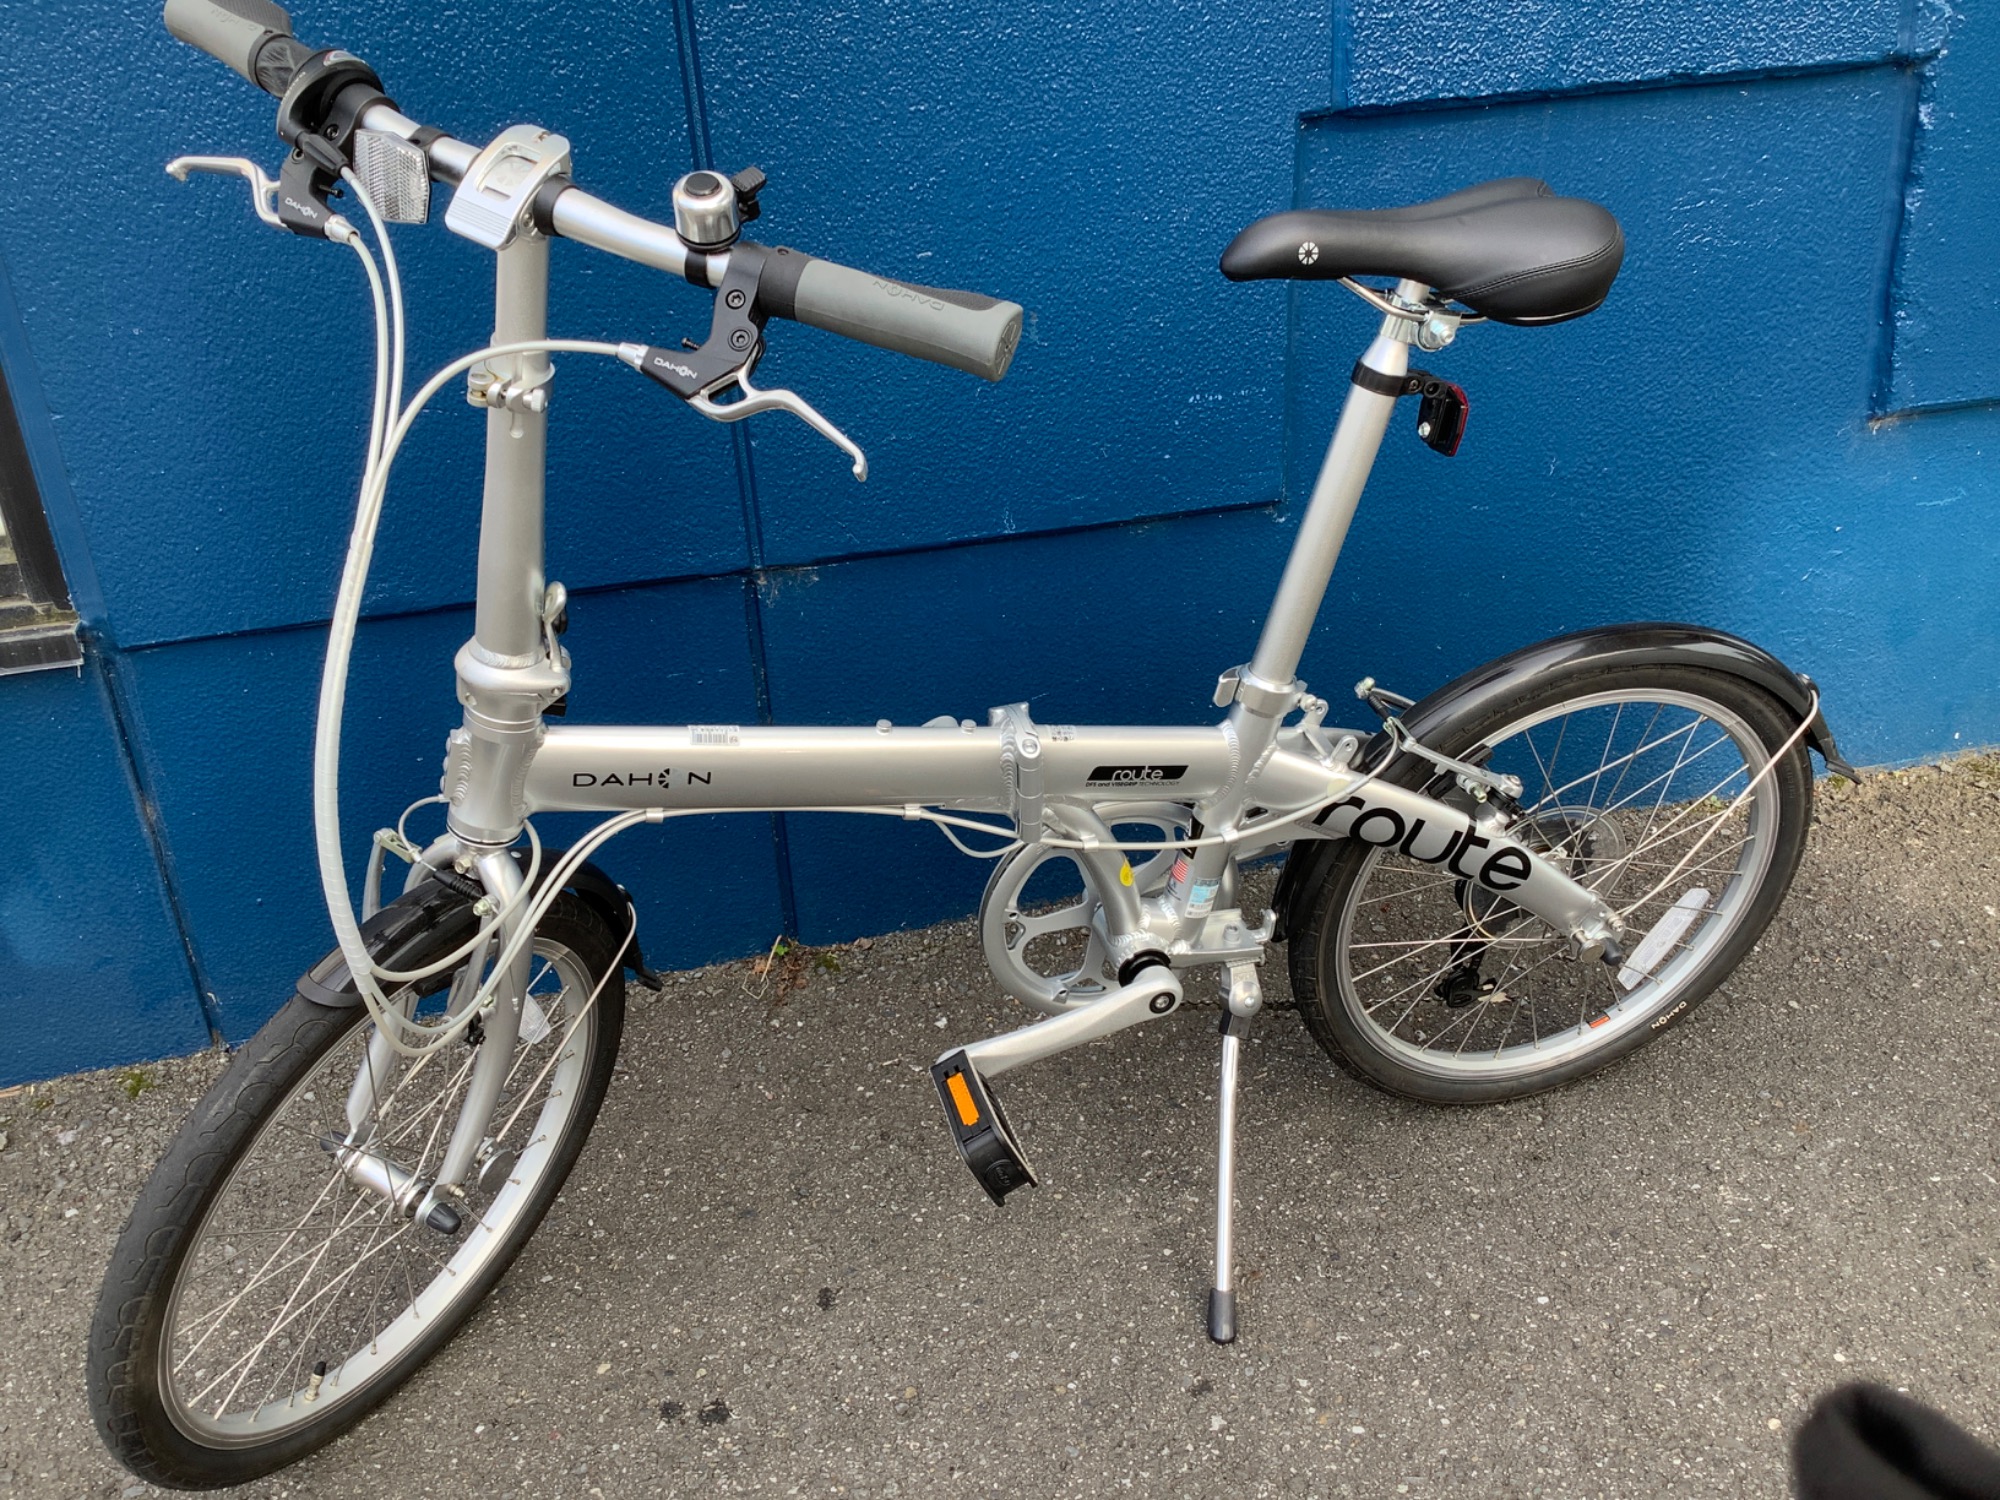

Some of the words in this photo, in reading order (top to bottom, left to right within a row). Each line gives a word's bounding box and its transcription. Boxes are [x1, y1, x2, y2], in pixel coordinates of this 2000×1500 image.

[284, 197, 318, 219] DAHON
[653, 357, 698, 379] DAHON
[1111, 765, 1164, 781] route
[1312, 796, 1532, 891] route
[1651, 1001, 1687, 1029] DAHON
